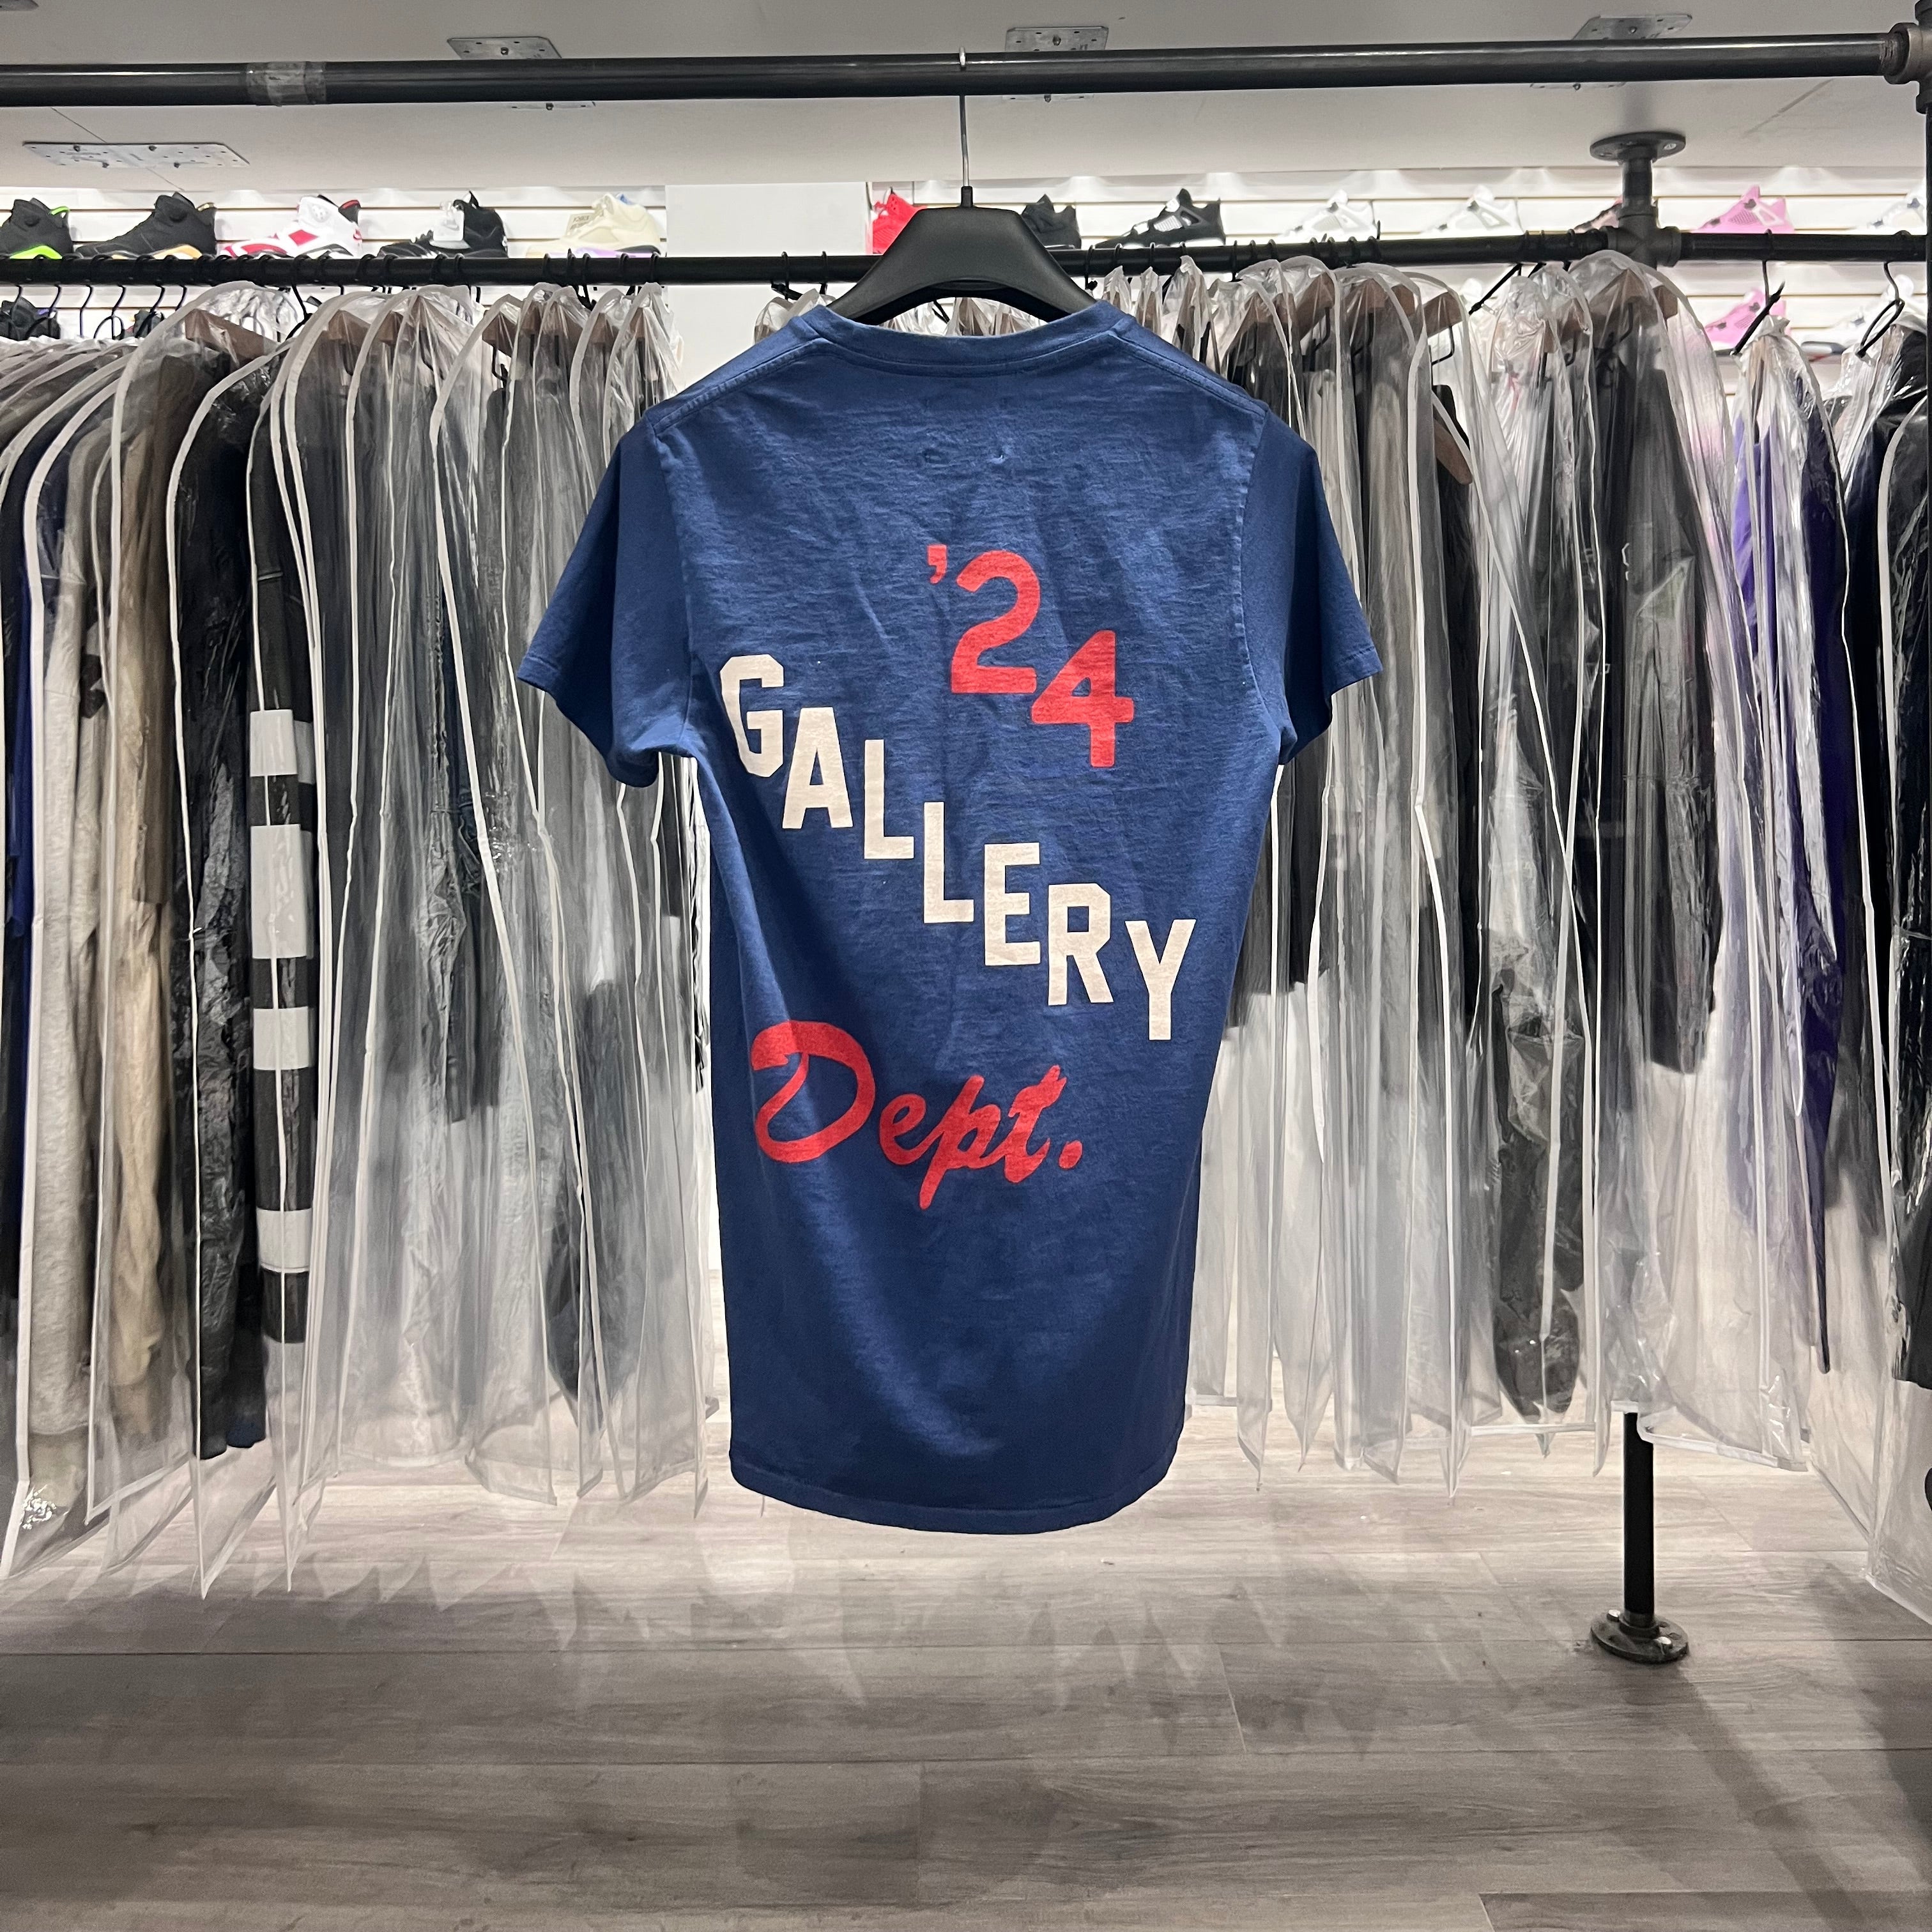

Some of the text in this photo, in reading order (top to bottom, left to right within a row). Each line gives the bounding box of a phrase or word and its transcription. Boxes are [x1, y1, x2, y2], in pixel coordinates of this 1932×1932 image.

[926, 544, 1135, 768] '24
[719, 654, 1197, 1041] GALLERY
[750, 1020, 1084, 1210] Dept.
